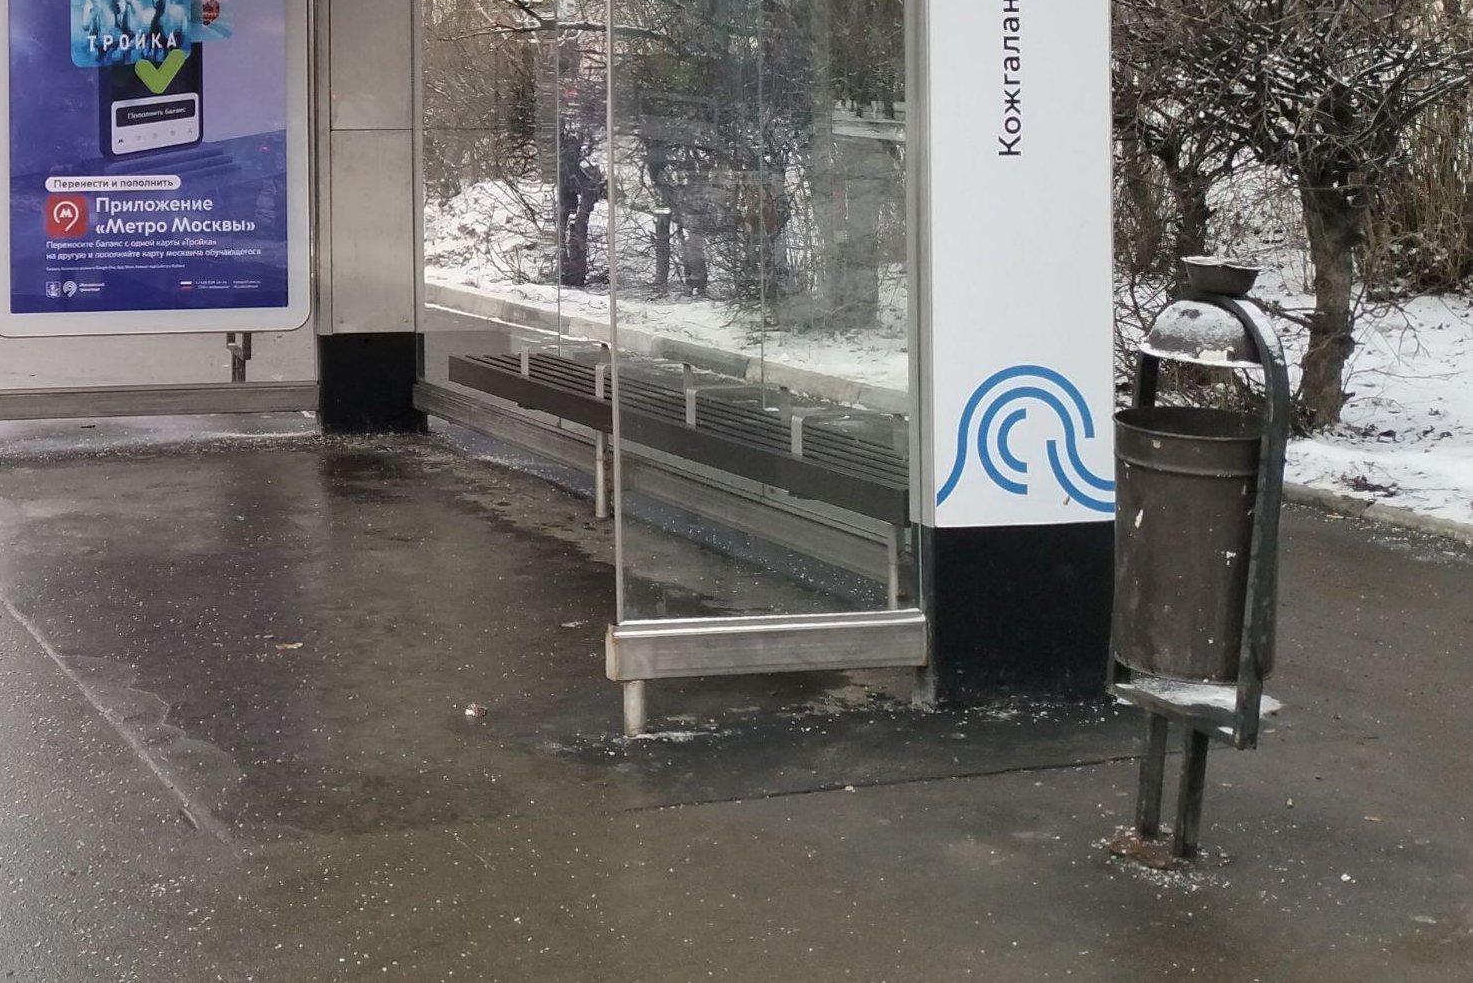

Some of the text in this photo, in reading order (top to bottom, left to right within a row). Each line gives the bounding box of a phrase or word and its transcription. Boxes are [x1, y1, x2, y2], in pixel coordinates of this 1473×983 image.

[86, 29, 177, 52] ТРОЙКА
[127, 110, 164, 120] Пополнить
[53, 179, 109, 190] Перенести
[120, 179, 174, 187] пополнить
[95, 197, 214, 216] Приложение
[95, 217, 256, 237] «Метро Москвы»
[46, 241, 94, 250] Переносите
[95, 239, 123, 248] баланс
[130, 239, 155, 248] одной
[156, 239, 180, 248] карты
[57, 252, 87, 261] другую
[142, 249, 165, 259] карту
[166, 248, 204, 257] москвича
